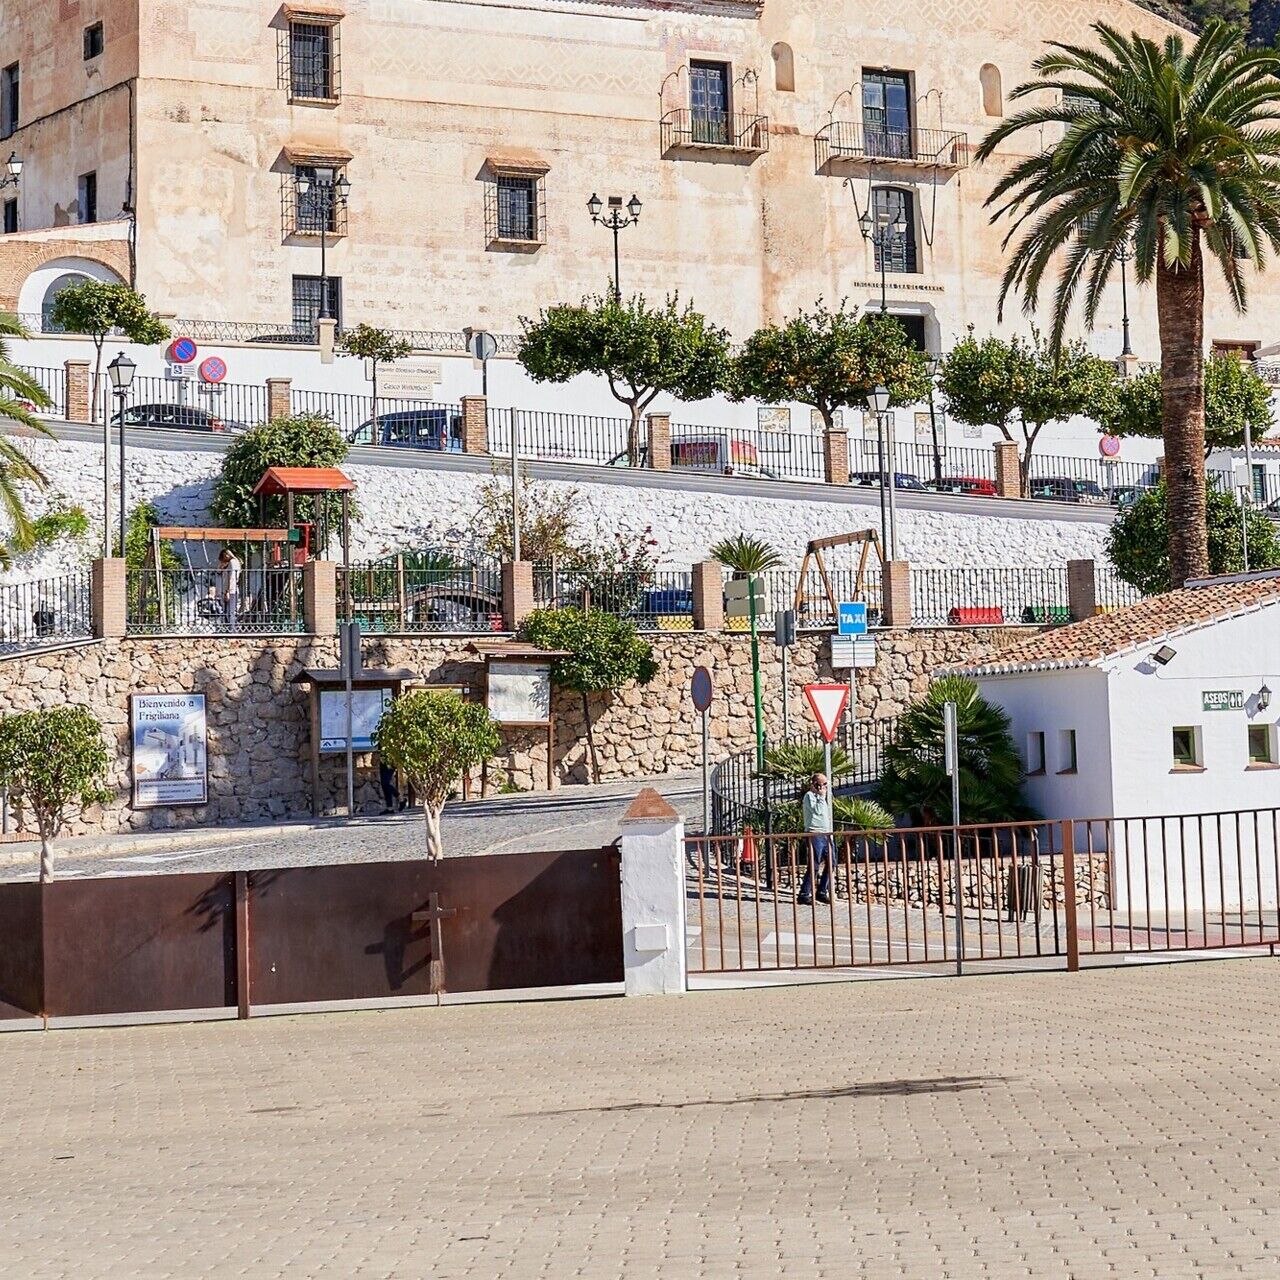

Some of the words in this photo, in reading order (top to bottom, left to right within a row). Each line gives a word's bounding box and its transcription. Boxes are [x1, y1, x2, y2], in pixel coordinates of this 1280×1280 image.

[840, 613, 865, 624] TAXI
[1204, 693, 1228, 704] ASEOS
[138, 699, 186, 709] Bienvenido
[138, 711, 180, 721] Frigiliana
